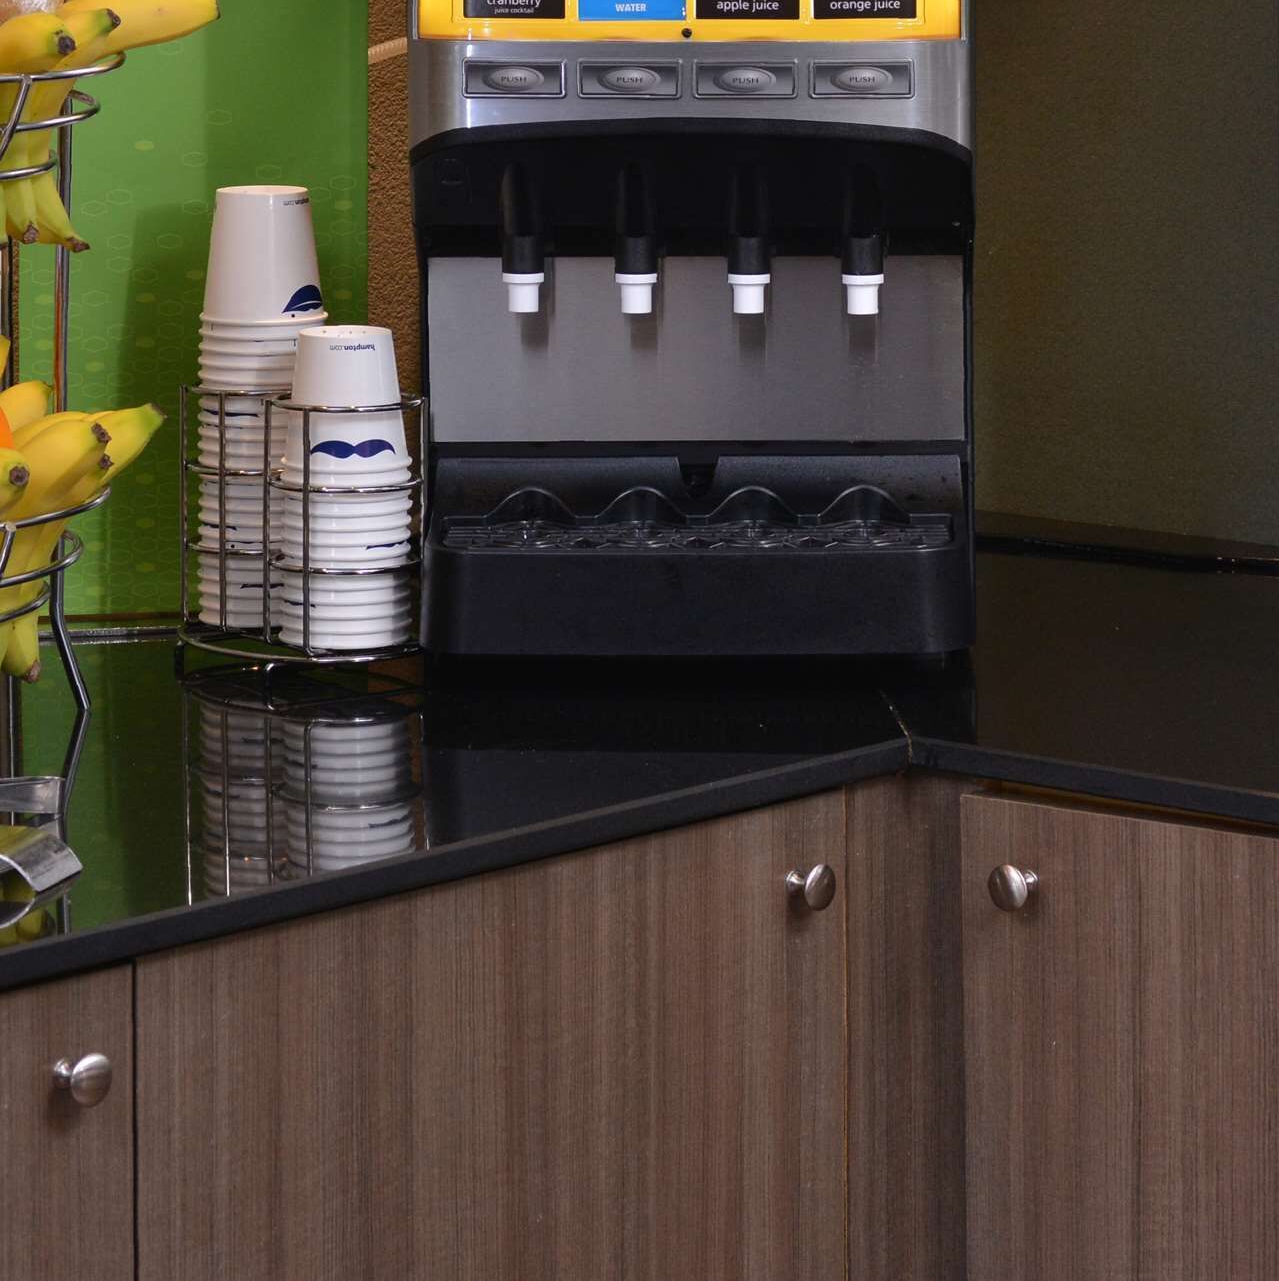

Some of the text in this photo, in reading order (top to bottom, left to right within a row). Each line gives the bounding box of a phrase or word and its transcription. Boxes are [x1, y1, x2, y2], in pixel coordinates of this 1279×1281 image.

[494, 6, 535, 15] juice cocktail
[615, 2, 647, 12] WATER
[751, 0, 780, 12] juice
[830, 0, 871, 12] orange
[500, 76, 528, 84] PUSH
[616, 76, 643, 84] PUSH
[732, 77, 760, 85] PUSH
[849, 76, 876, 84] PUSH
[329, 343, 376, 352] hampton.com
